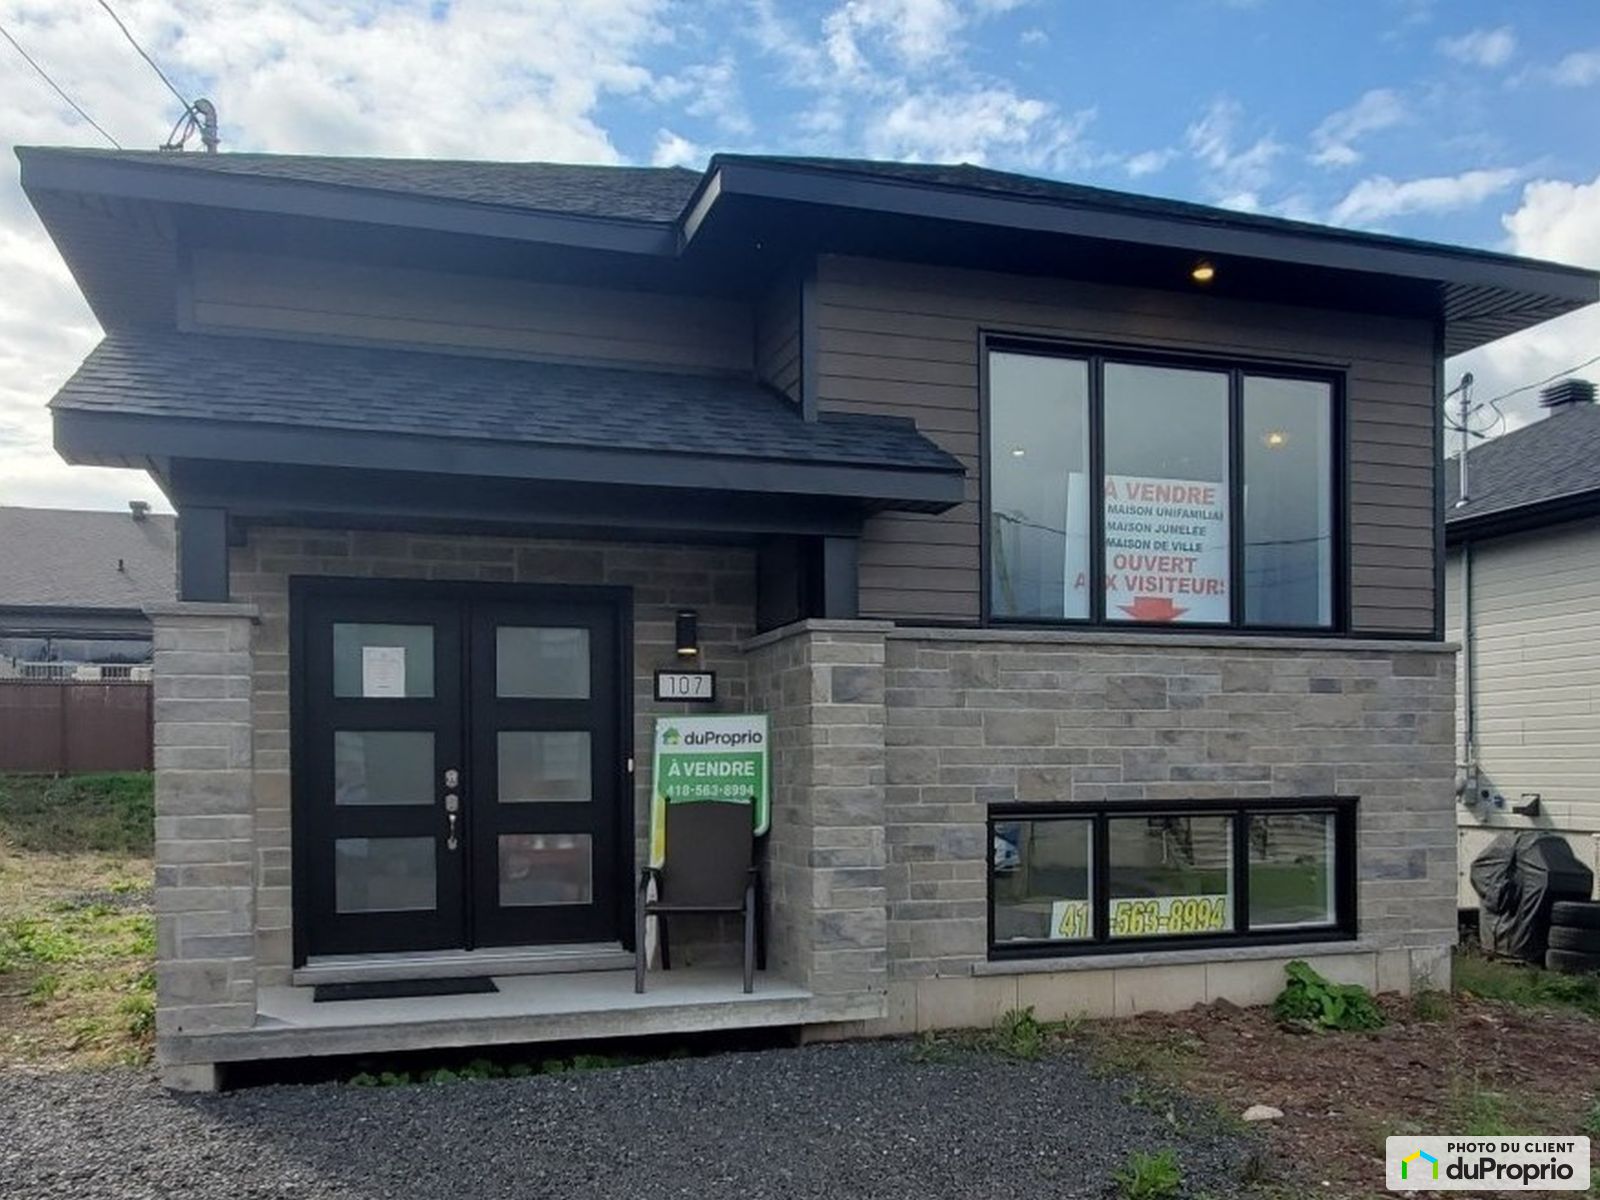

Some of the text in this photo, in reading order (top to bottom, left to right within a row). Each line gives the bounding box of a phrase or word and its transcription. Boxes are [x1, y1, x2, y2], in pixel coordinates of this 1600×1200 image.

[1126, 482, 1215, 505] VENDRE
[1107, 504, 1153, 517] MAISON
[1106, 521, 1151, 533] MAISON
[1105, 538, 1203, 553] MAISON DE VILLE
[1113, 554, 1198, 573] OUVERT
[1074, 572, 1118, 591] AX
[667, 676, 703, 695] 107
[684, 730, 763, 746] duProprio
[668, 758, 755, 777] À VENDRE
[1058, 899, 1226, 938] 41-563-8994
